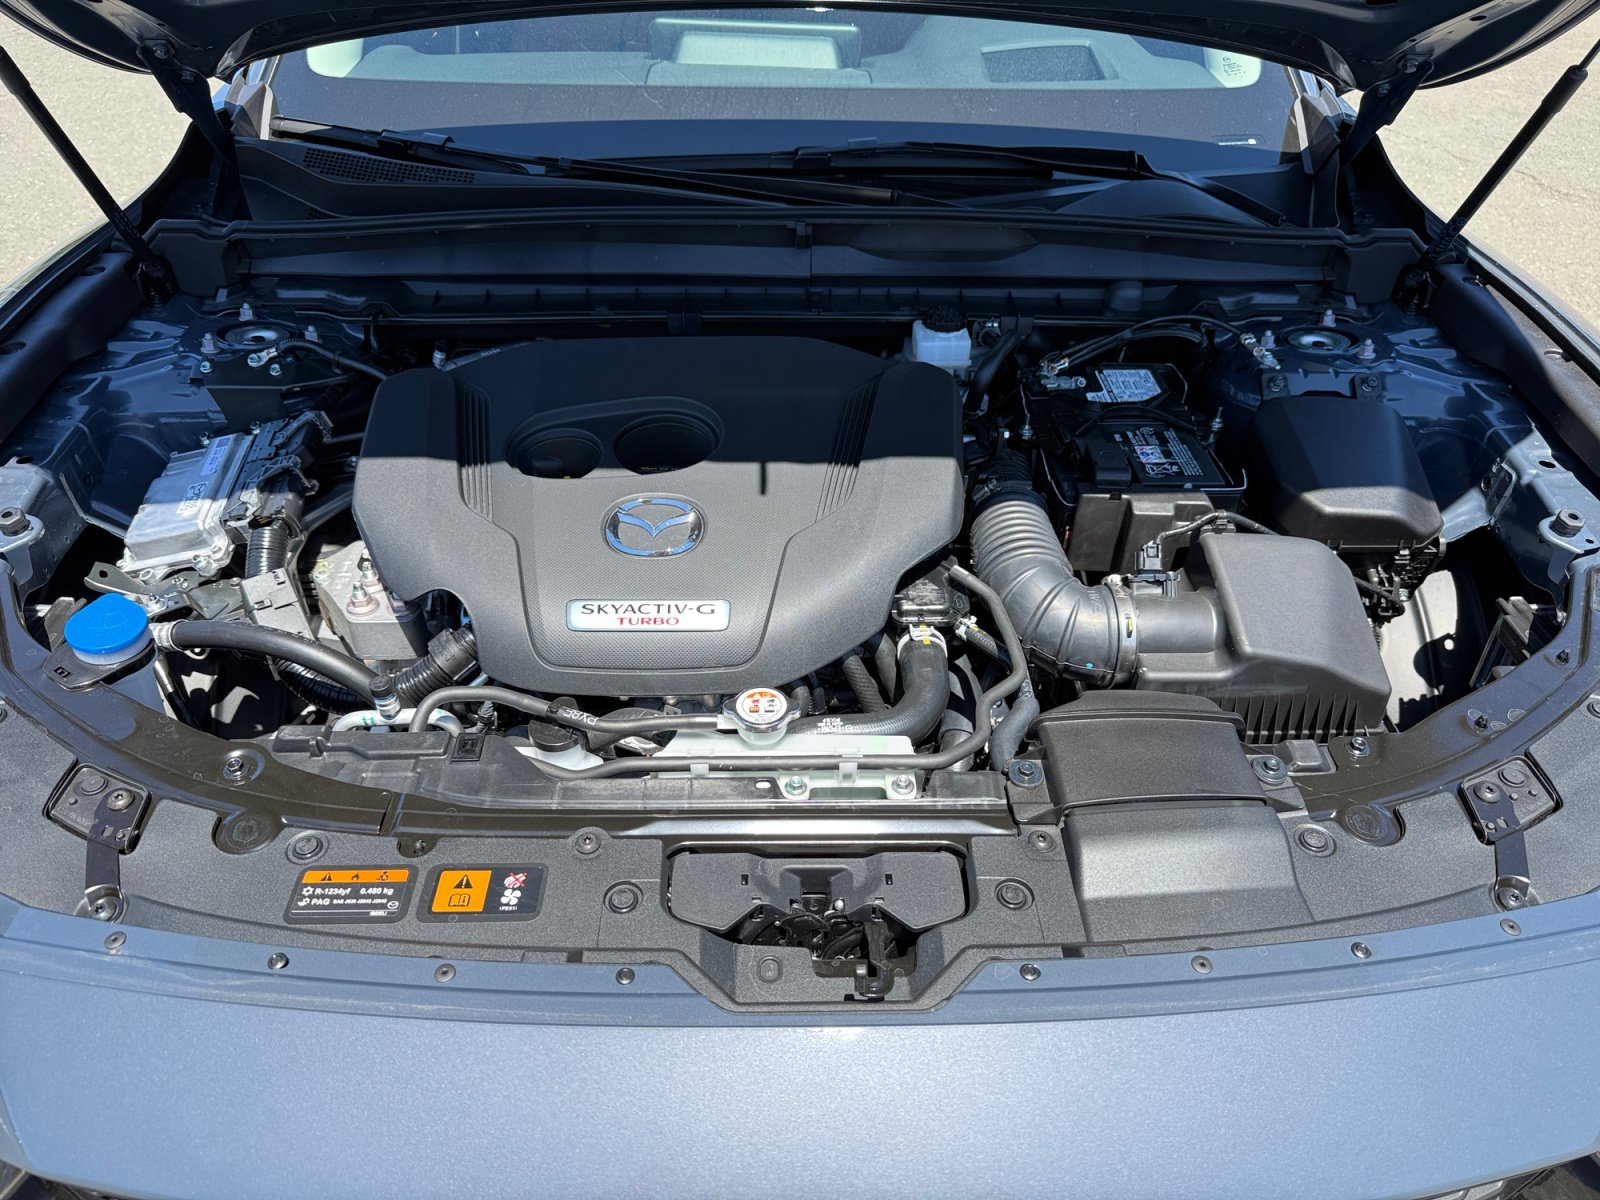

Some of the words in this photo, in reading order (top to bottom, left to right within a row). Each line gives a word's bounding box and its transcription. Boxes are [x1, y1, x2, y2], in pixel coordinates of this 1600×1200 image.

[581, 604, 716, 615] SKYACTIV-G
[616, 617, 680, 626] TURBO
[314, 887, 352, 896] R-1234yf
[360, 887, 381, 895] 0.480
[383, 887, 394, 896] kg
[311, 898, 331, 906] PAG
